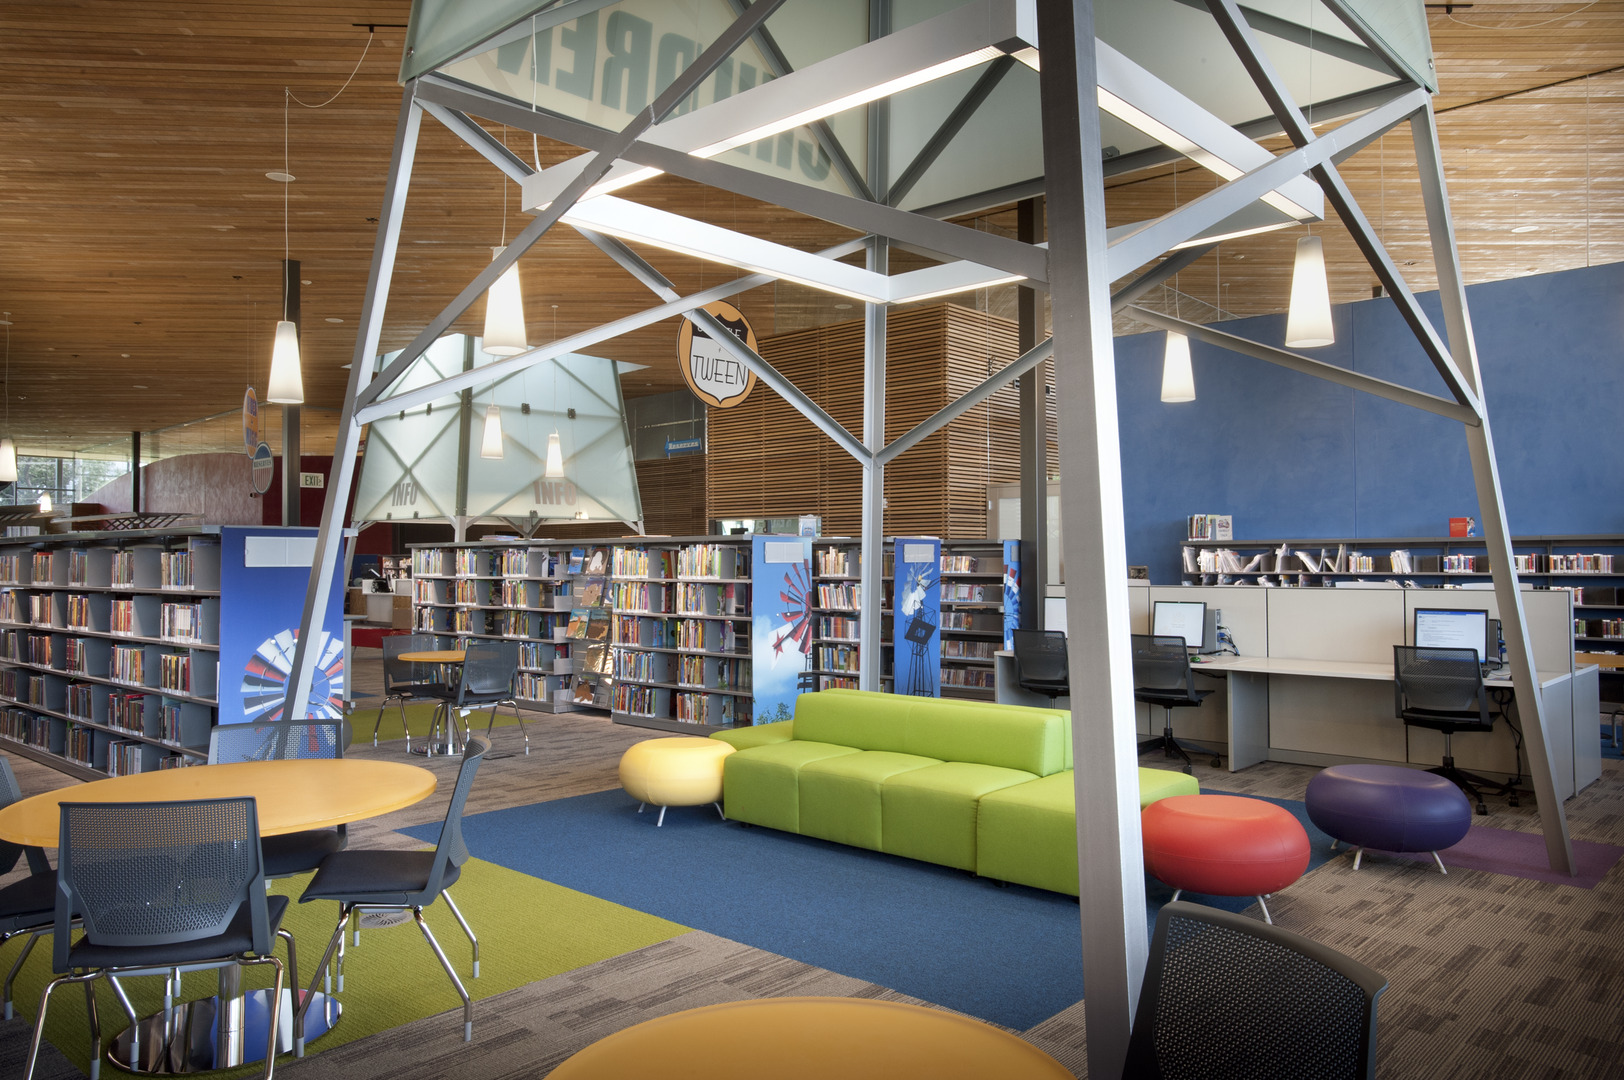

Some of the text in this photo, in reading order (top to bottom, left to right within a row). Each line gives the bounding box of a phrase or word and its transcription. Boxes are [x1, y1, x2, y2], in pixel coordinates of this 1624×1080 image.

[693, 354, 746, 386] TWEEN
[304, 475, 319, 486] EXIT
[391, 482, 418, 507] INFO
[533, 481, 577, 506] INFO
